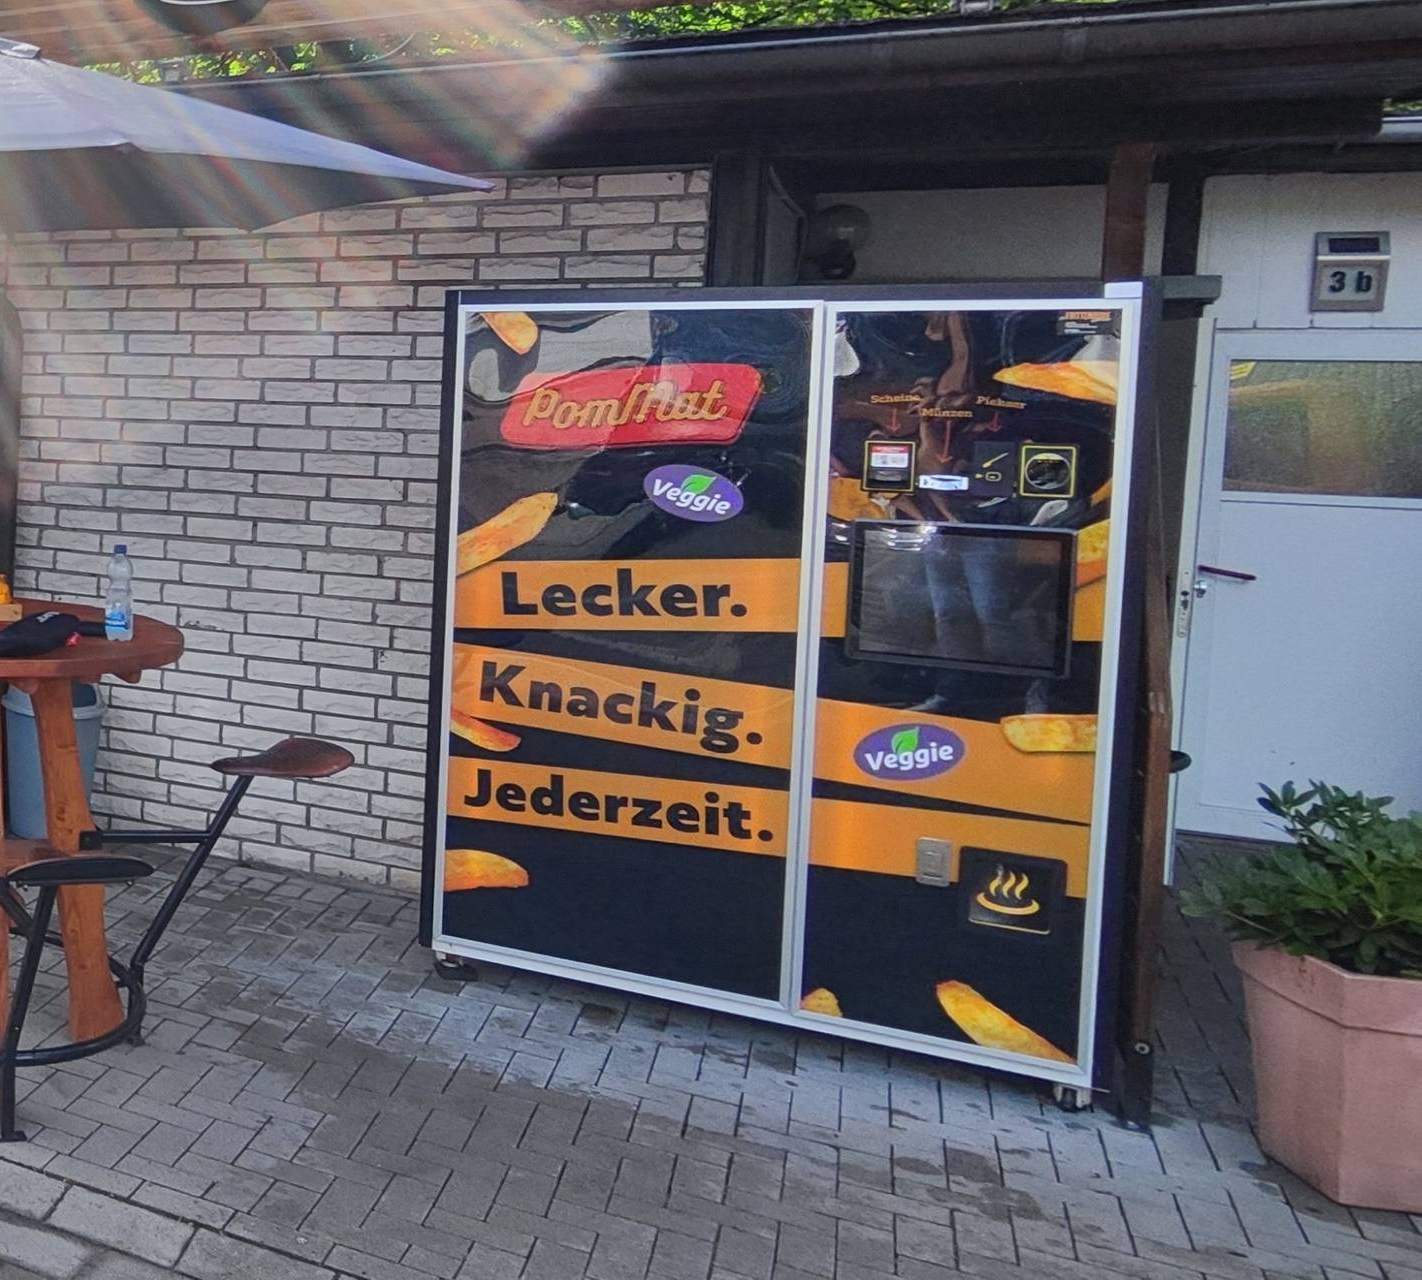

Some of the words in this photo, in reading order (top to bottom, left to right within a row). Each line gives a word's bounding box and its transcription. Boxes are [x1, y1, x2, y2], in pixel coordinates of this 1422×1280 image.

[1329, 271, 1346, 293] 3
[1355, 271, 1373, 293] b
[523, 379, 730, 430] PomMat
[652, 478, 731, 515] Veggie
[501, 568, 748, 617] Lecker.
[479, 660, 763, 754] Knackig.
[864, 742, 954, 772] Veggie
[464, 769, 774, 842] Jederzeit.
